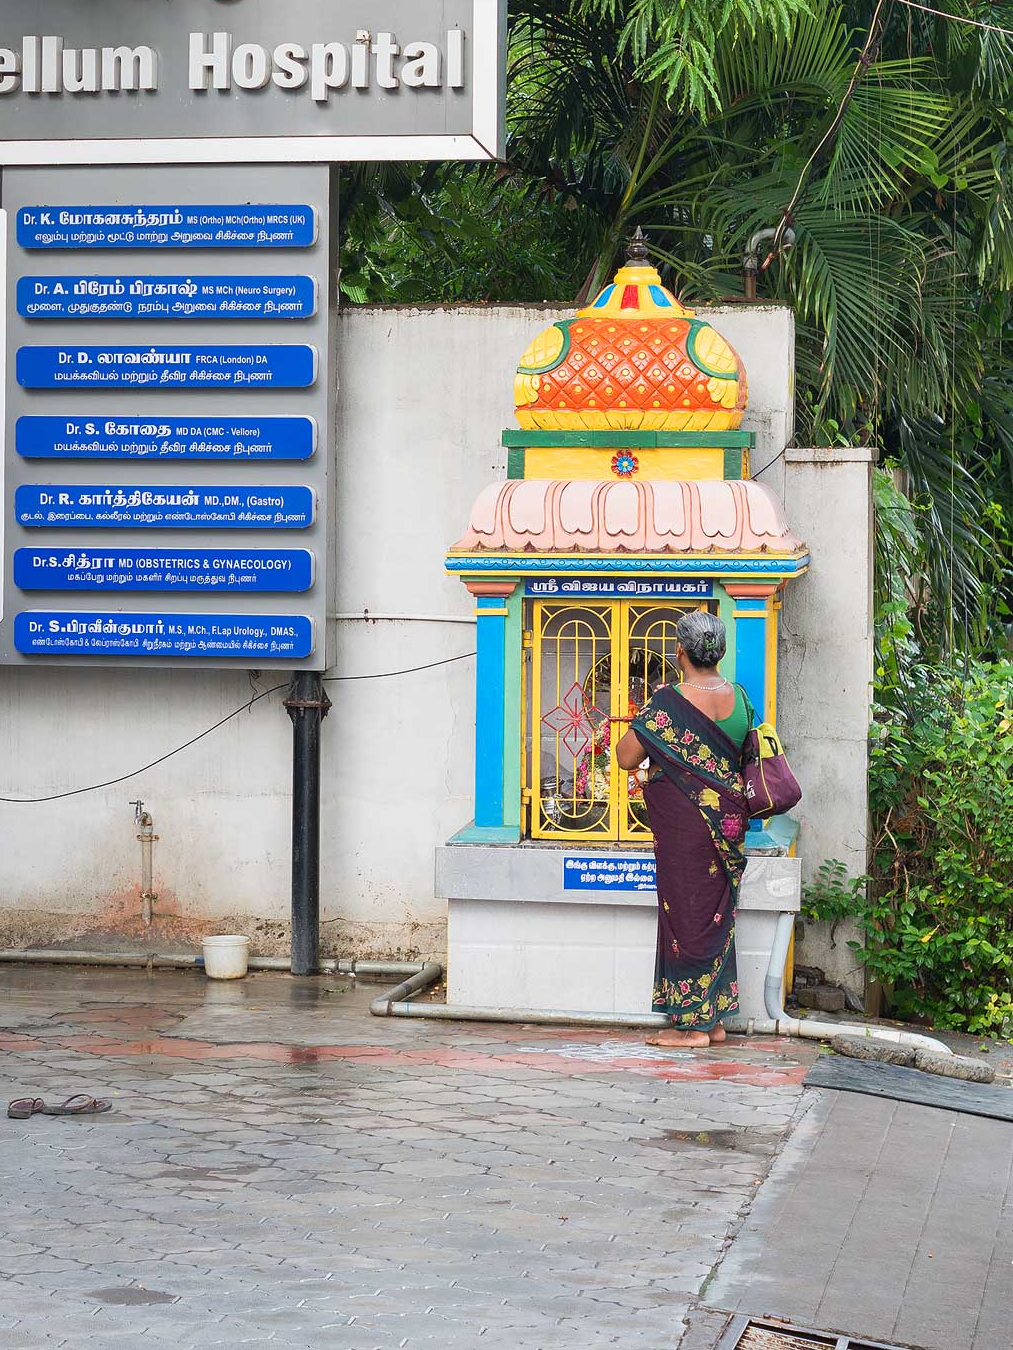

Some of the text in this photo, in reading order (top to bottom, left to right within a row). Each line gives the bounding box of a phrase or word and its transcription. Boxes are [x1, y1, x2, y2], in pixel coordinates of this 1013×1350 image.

[188, 28, 466, 103] Hospital
[24, 214, 37, 224] Dr.
[41, 213, 54, 224] K.
[60, 209, 183, 227] மோகனசுந்தரம்
[187, 216, 197, 224] MS
[200, 216, 224, 225] (Ortho)
[290, 216, 305, 225] (UK)
[35, 279, 295, 297] Dr. A. பிரேம் பிரகாஷ் MS MCh (Neuro Surgery)
[59, 352, 73, 363] Dr.
[78, 352, 92, 363] D.
[98, 348, 191, 363] லாவண்யா
[220, 356, 254, 365] (London)
[40, 493, 55, 504] Dr.
[59, 493, 73, 504] R.
[79, 490, 199, 508] கார்த்திகேயன்
[247, 496, 283, 508] (Gastro)
[119, 559, 133, 567] MD
[136, 559, 200, 568] (OBSTETRICS
[203, 559, 209, 568] &
[213, 559, 291, 570] GYNAECOLOGY)
[562, 580, 614, 592] விஜய
[617, 580, 709, 594] விநாயகர்
[30, 622, 44, 632] Dr.
[169, 625, 185, 636] M.S.,
[188, 626, 210, 635] M.Ch.,
[212, 626, 231, 636] F.Lap
[234, 626, 267, 637] Urology.,
[271, 627, 298, 636] DMAS.,
